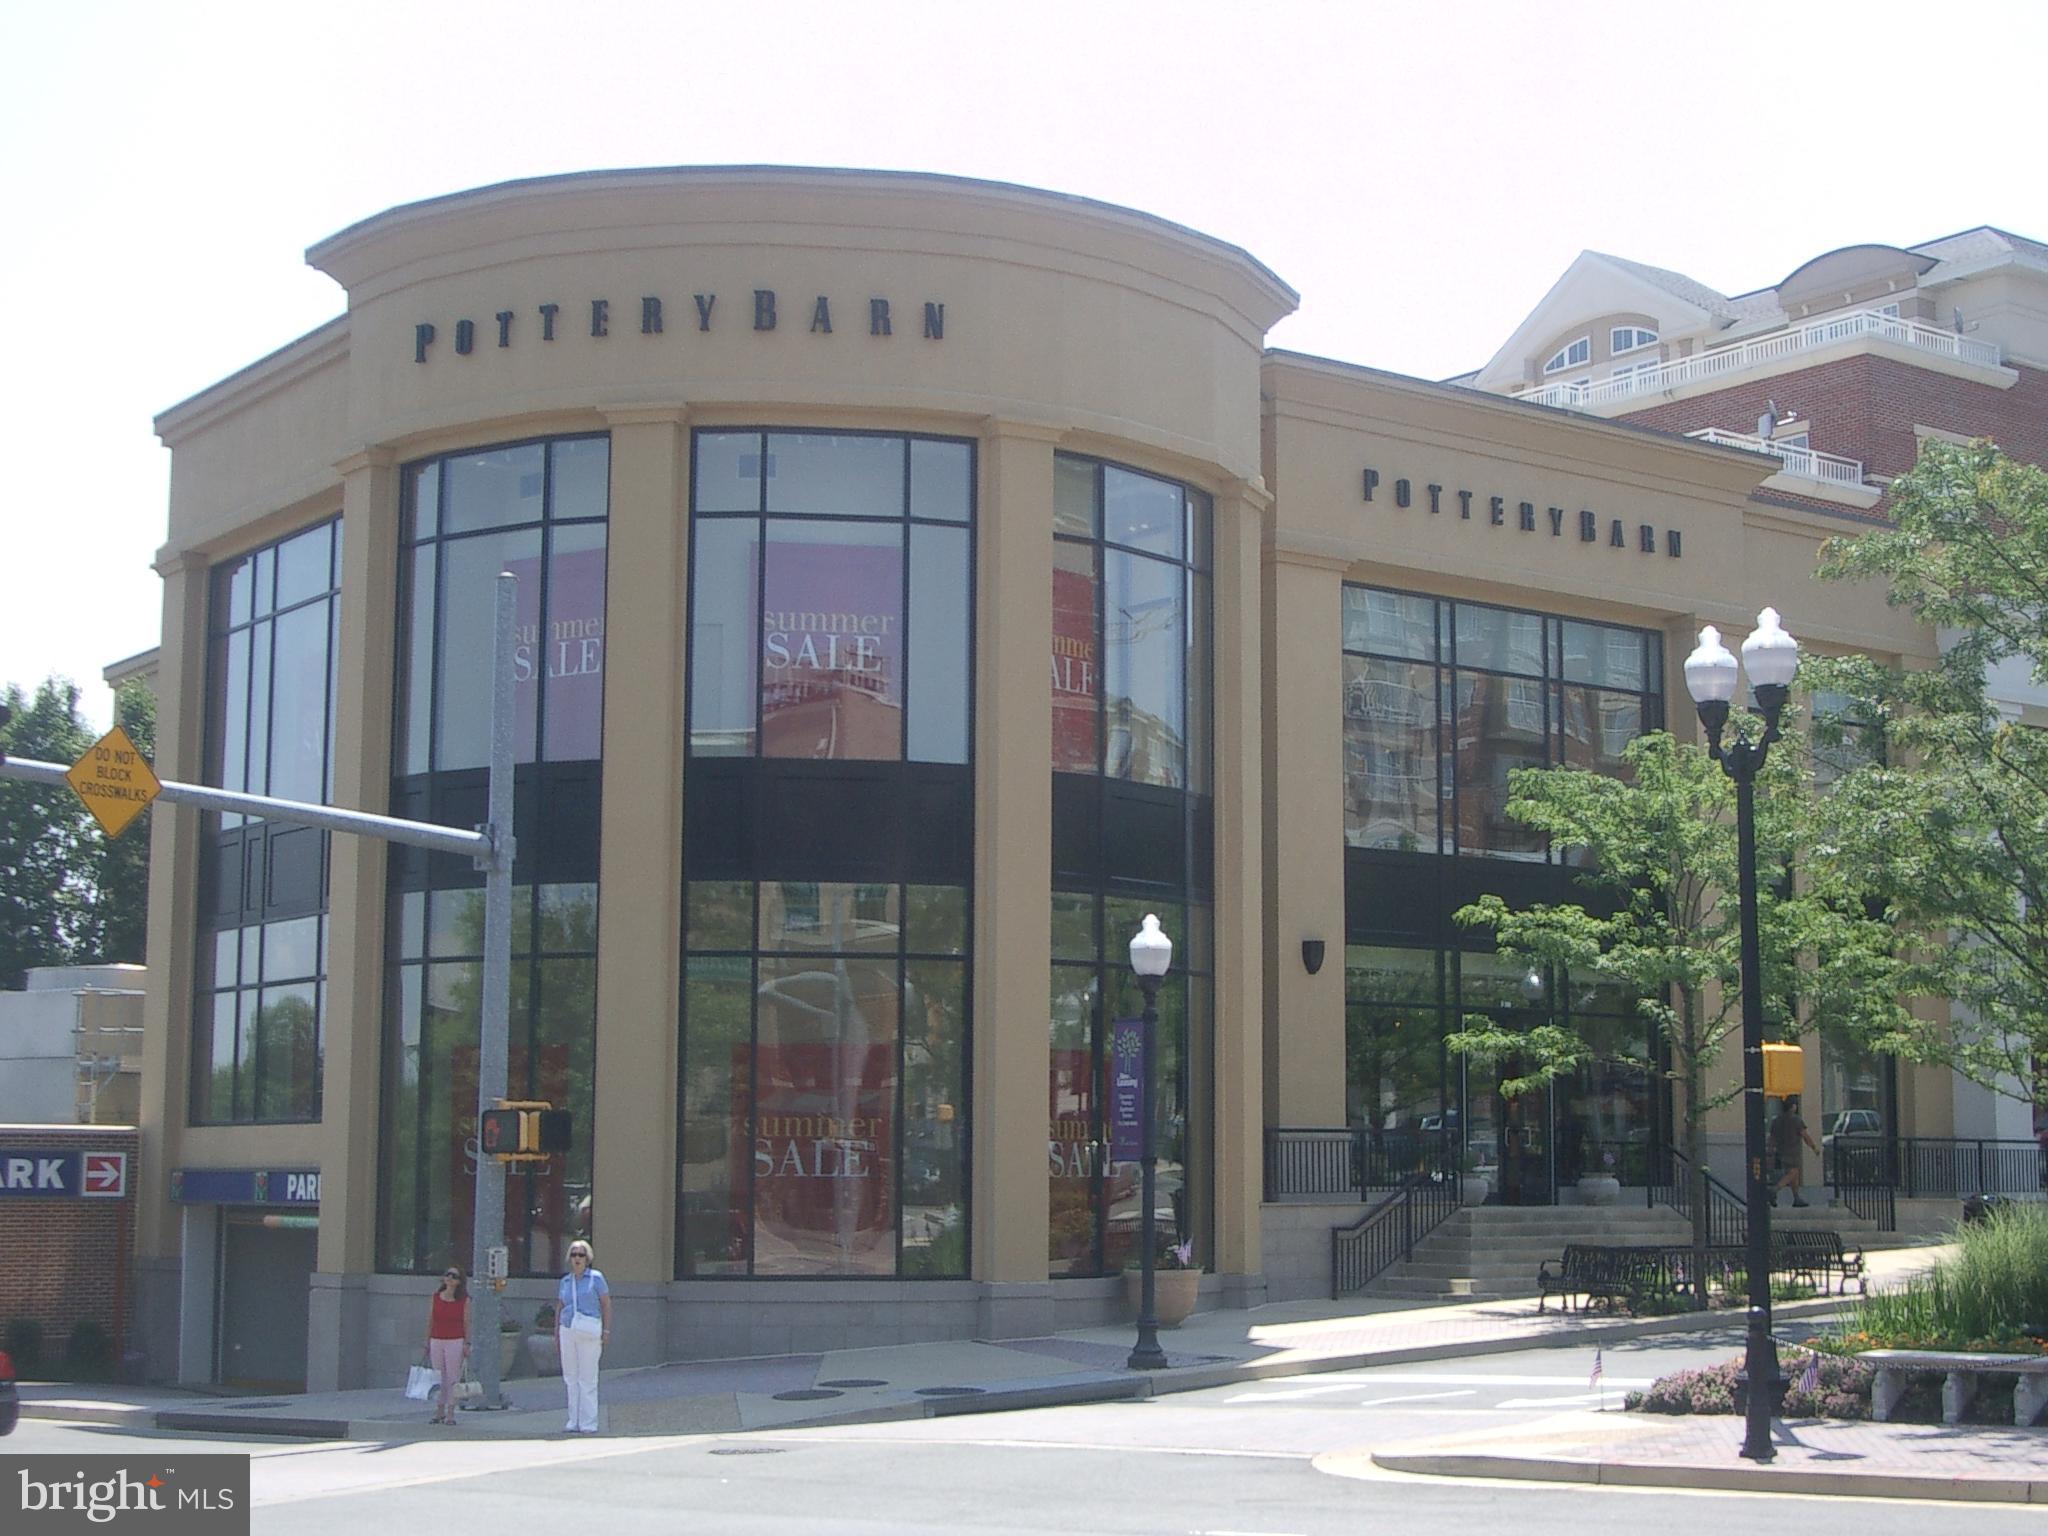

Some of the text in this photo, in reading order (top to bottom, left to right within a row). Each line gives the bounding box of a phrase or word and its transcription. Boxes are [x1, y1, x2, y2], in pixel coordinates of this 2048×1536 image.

[764, 610, 895, 634] summer
[766, 631, 882, 672] SALE
[95, 747, 136, 765] DO NOT
[96, 766, 132, 782] BLOCK
[79, 781, 147, 802] CROSSWALKS
[754, 1138, 869, 1177] SALE
[0, 1158, 65, 1189] RK
[286, 1173, 321, 1201] PAR
